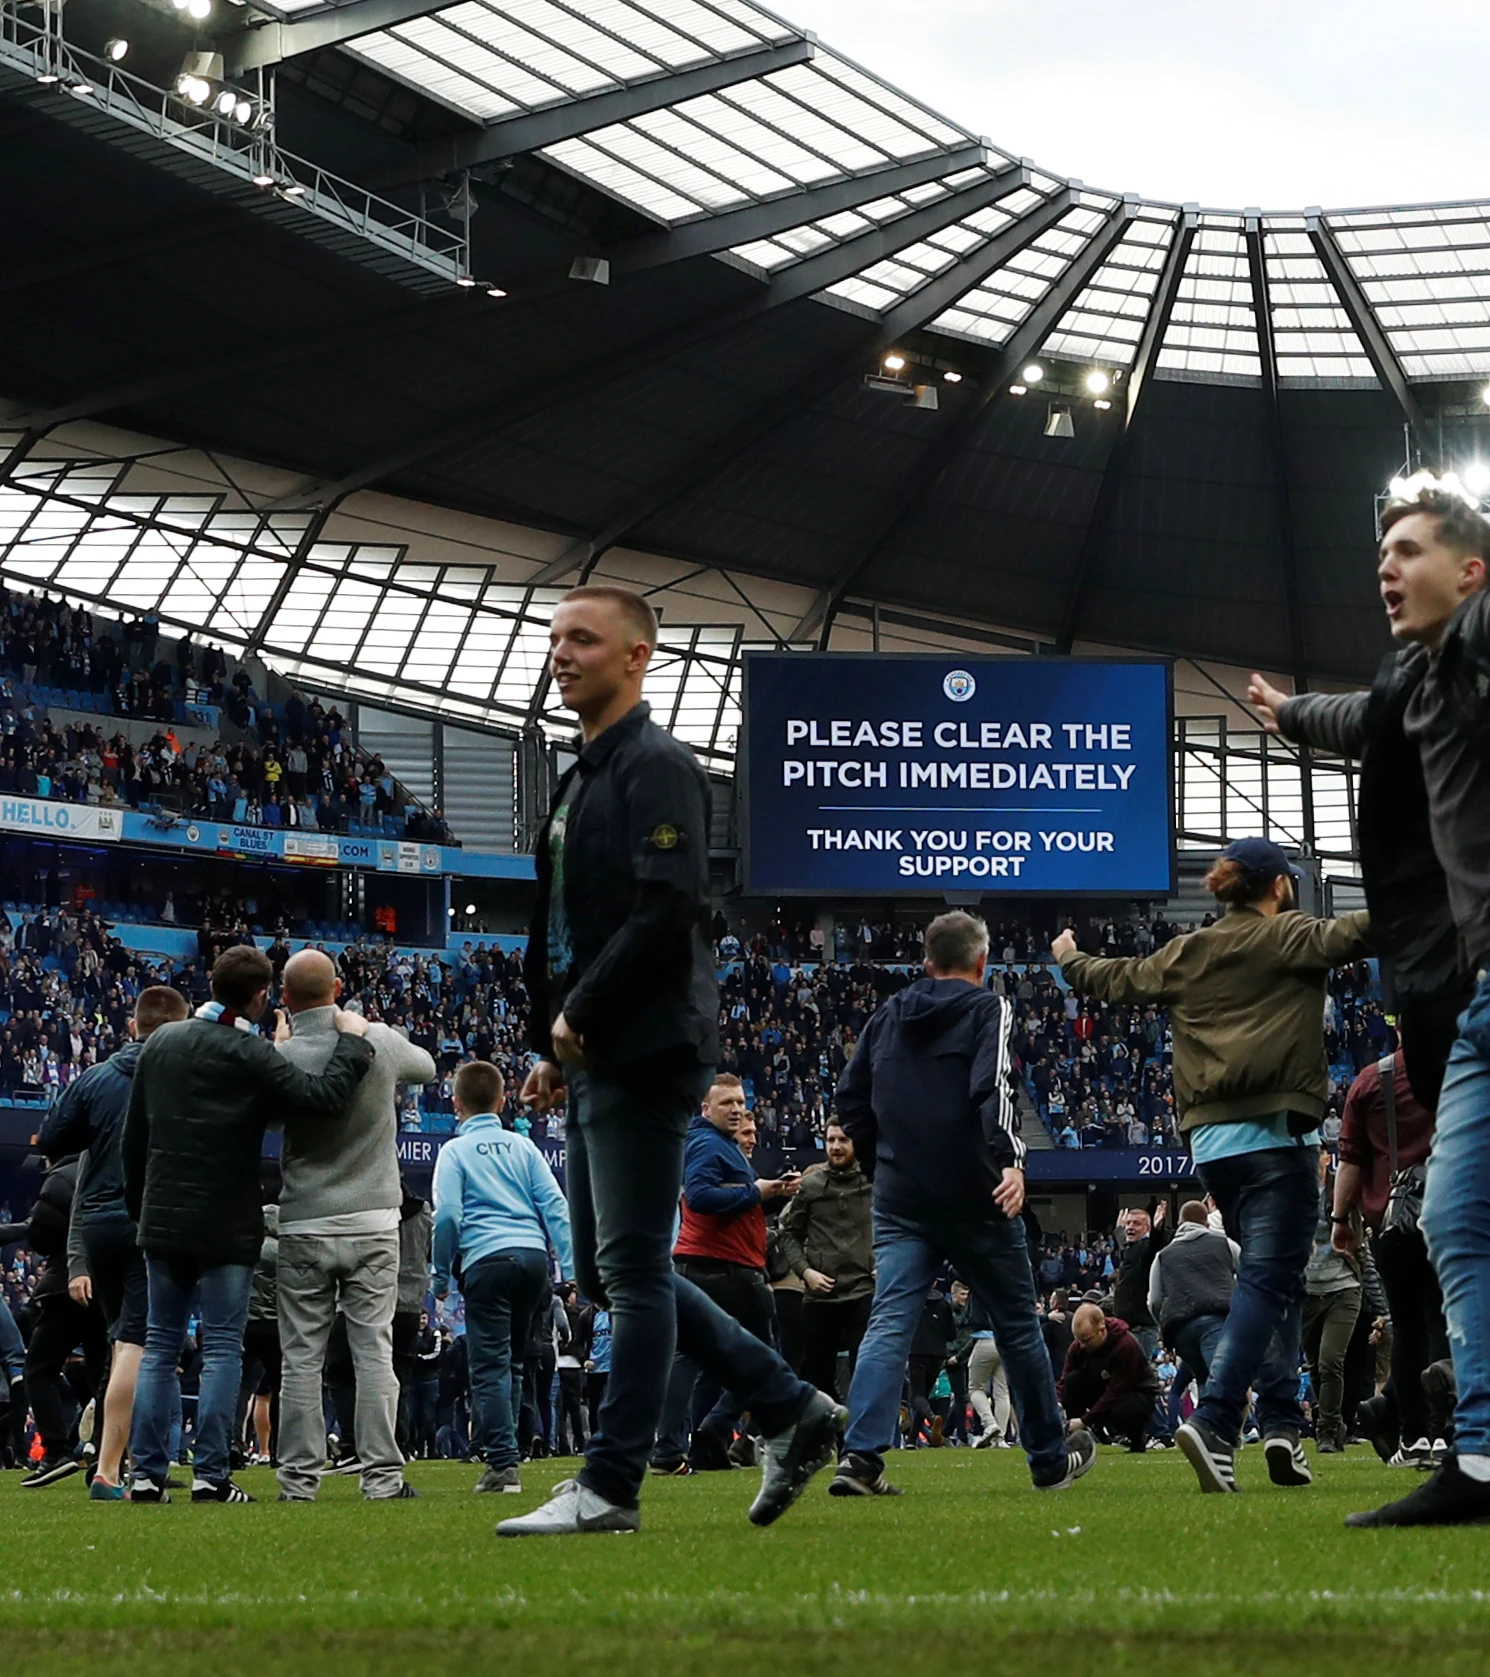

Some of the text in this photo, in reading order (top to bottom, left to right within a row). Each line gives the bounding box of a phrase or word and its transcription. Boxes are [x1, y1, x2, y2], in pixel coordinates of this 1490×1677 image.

[786, 720, 1132, 750] PLEASE CLEAR THE
[783, 760, 1137, 790] PITCH IMMEDIATELY
[2, 801, 77, 829] HELLO.
[233, 827, 261, 840] CANAL
[263, 831, 274, 841] ST
[239, 838, 268, 850] BLUES
[806, 829, 1115, 852] THANK YOU FOR YOUR
[898, 855, 1026, 876] SUPPORT
[396, 1141, 432, 1161] MIER
[476, 1141, 514, 1156] CITY
